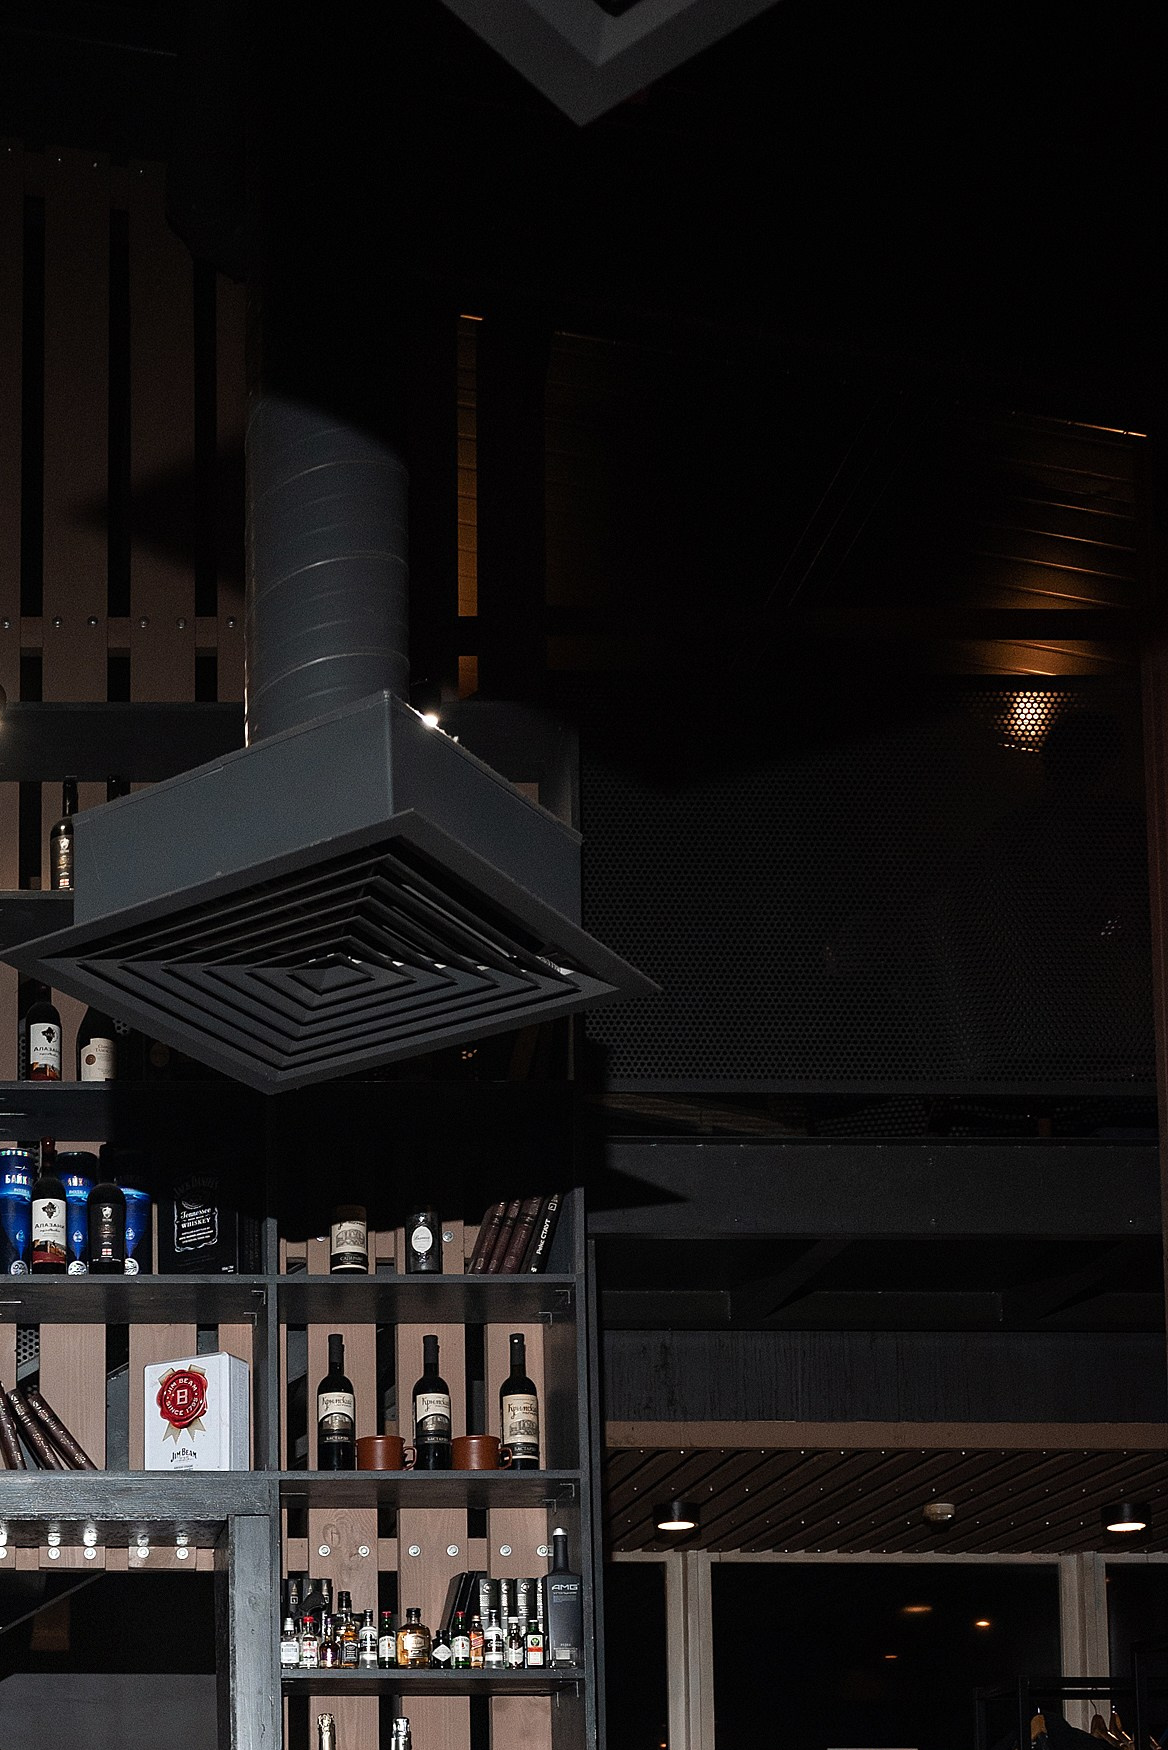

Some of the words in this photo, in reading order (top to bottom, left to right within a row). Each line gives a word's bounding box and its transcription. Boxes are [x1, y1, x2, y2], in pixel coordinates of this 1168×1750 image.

[181, 1217, 211, 1229] WHISKEY
[540, 1218, 551, 1240] СТАУТ
[167, 1381, 177, 1395] JIM
[179, 1378, 198, 1391] BEAM
[176, 1389, 188, 1405] B
[166, 1400, 184, 1416] SINCE
[170, 1451, 181, 1462] JIM
[181, 1448, 197, 1459] BEAM
